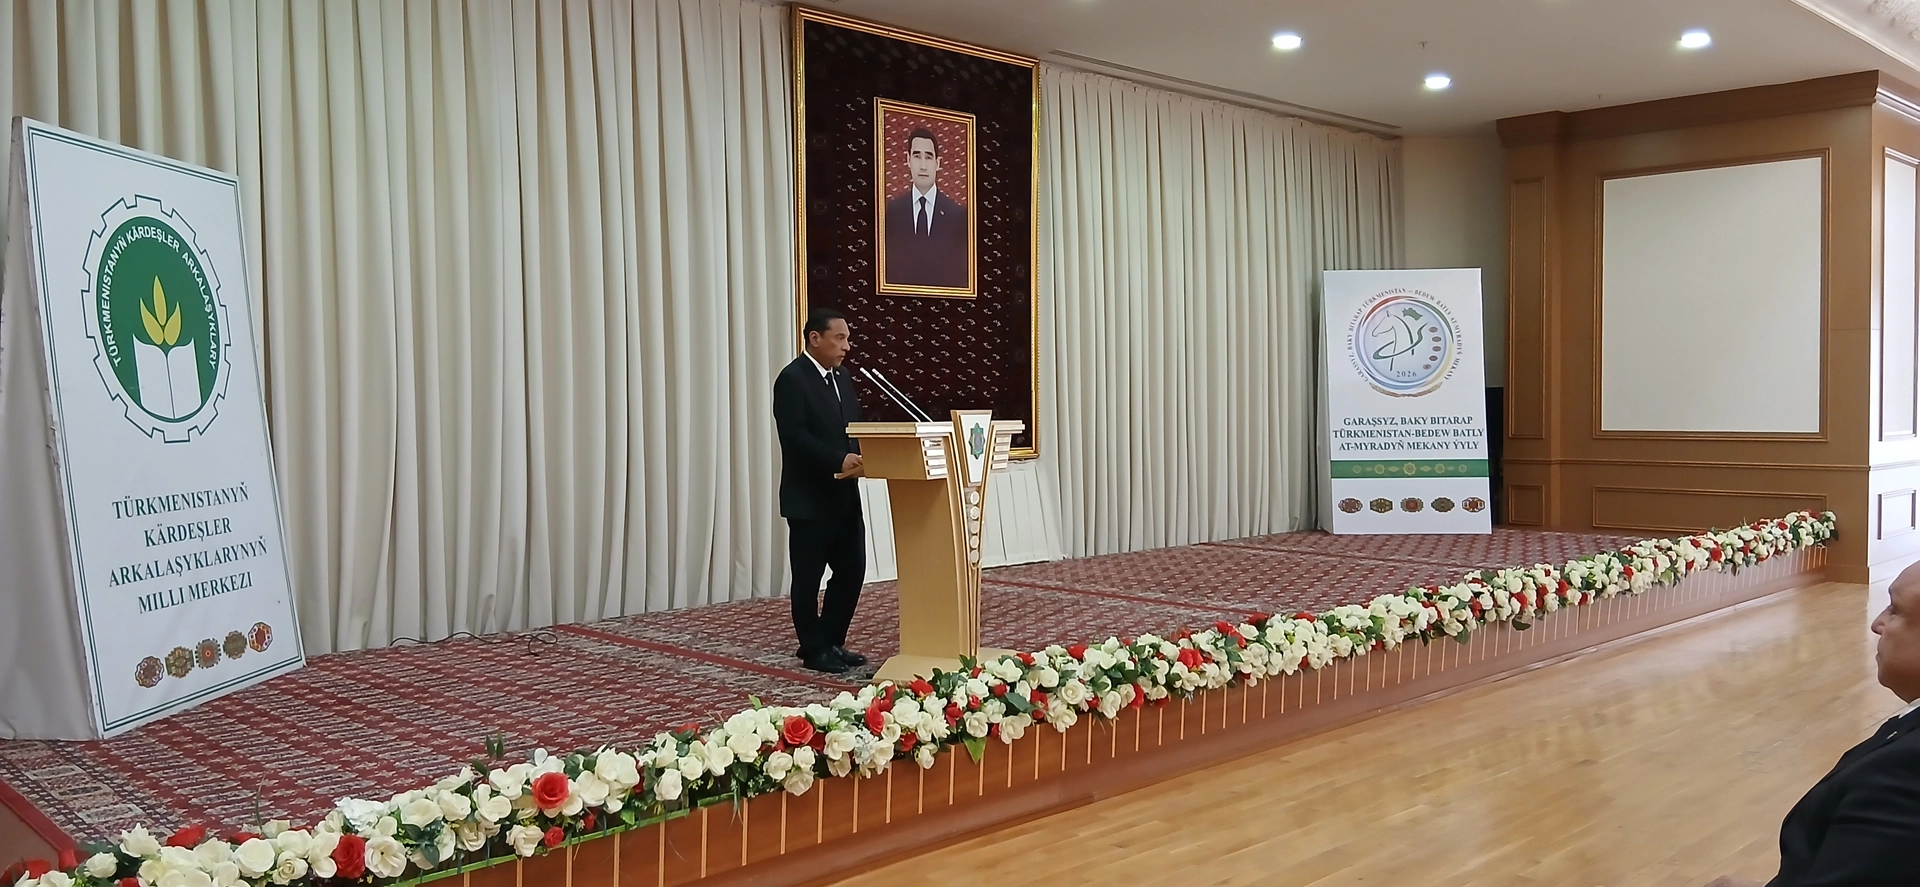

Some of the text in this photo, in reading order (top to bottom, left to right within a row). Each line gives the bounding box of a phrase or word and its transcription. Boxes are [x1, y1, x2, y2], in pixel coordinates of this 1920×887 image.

[126, 225, 180, 253] KÄRDEŞLER
[1396, 370, 1417, 378] 2026
[1332, 428, 1484, 439] TÜRKMENISTAN-BEDEW BATLY
[1343, 416, 1473, 427] GARAŞSYZ, BAKY BITARAP
[1339, 439, 1479, 451] AT-MYRADYŇ MEKANY ÝYLY
[112, 481, 249, 520] TÜRKMENISTANYŇ
[144, 517, 232, 548] KÄRDEŞLER
[109, 535, 267, 588] ARKALAŞYKLARYNYŇ
[138, 571, 253, 614] MILLI MERKEZI
